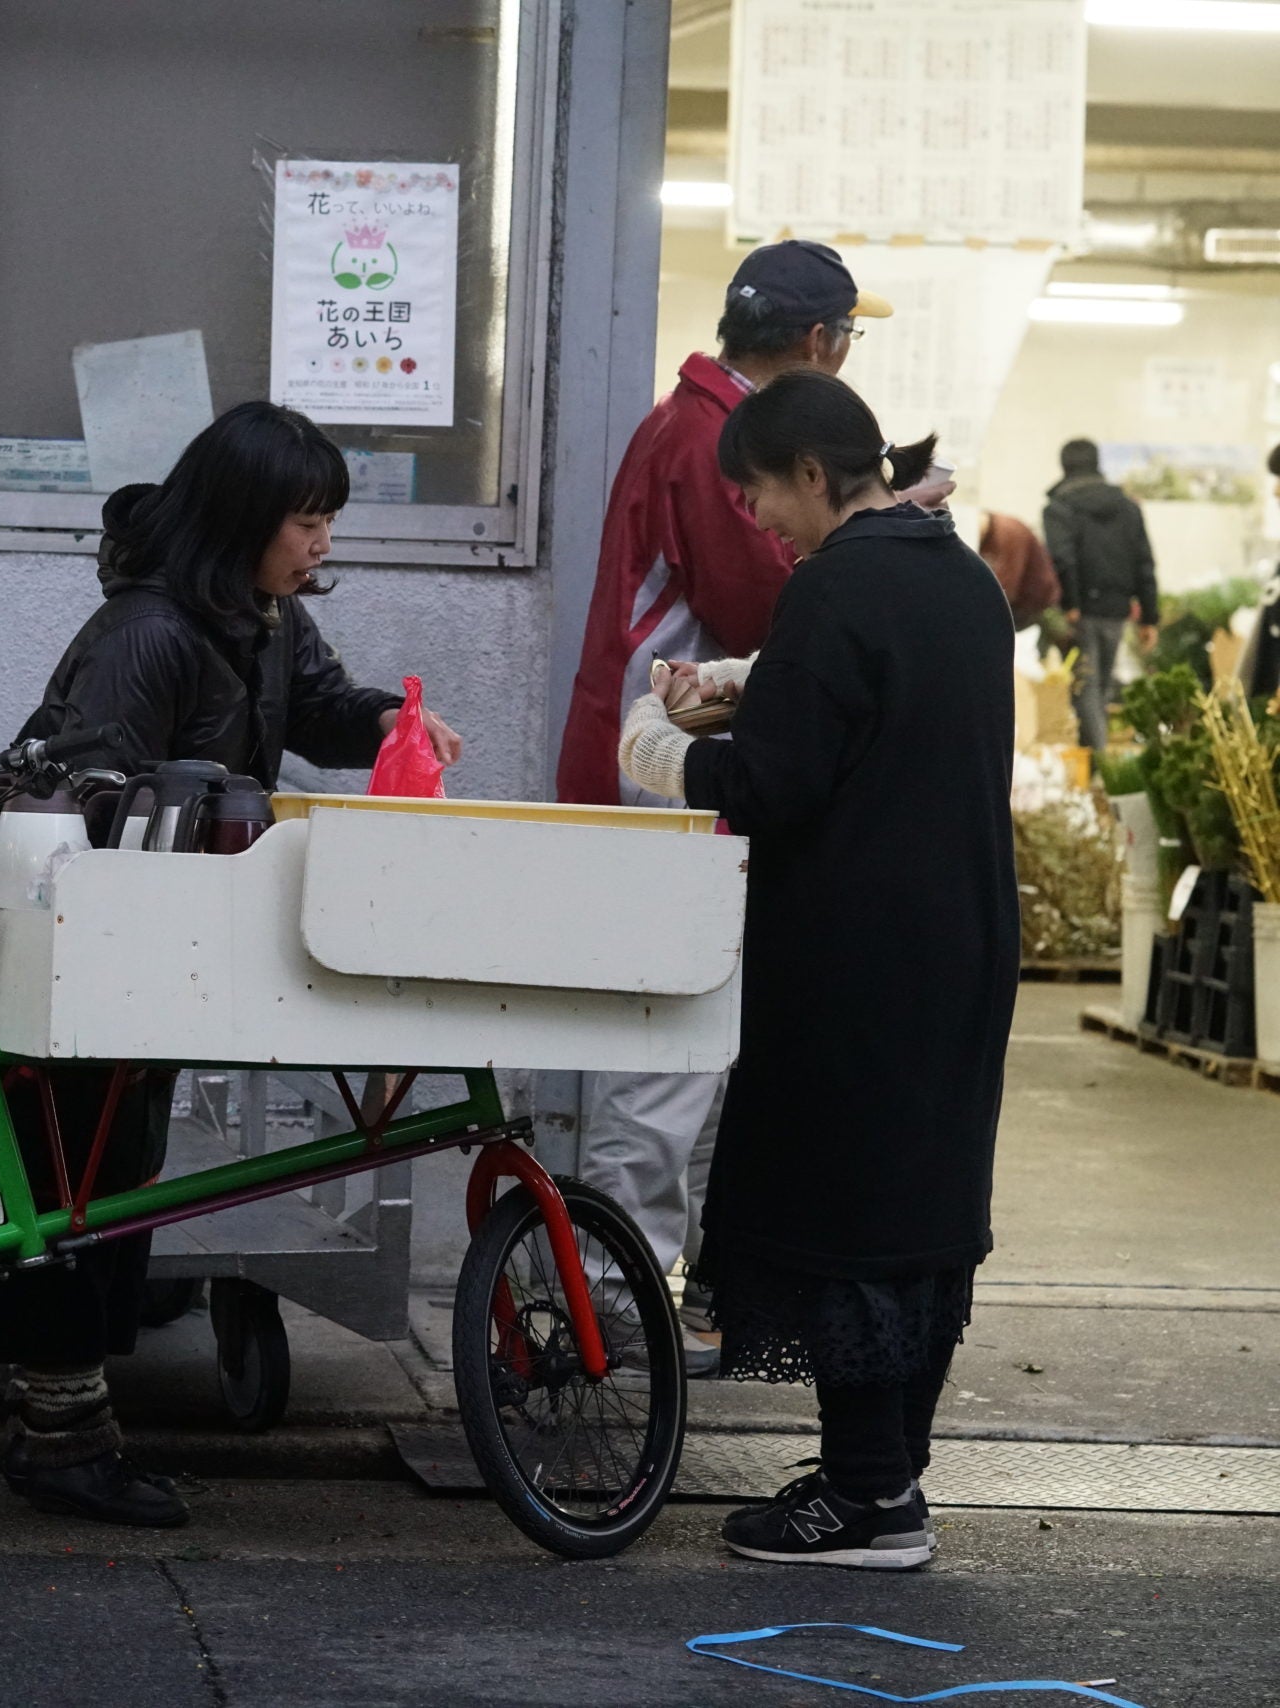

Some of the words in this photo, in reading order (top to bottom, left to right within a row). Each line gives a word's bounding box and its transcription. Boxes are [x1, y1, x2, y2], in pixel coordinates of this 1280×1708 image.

[317, 300, 411, 323] 花の王国
[789, 1497, 844, 1543] N
